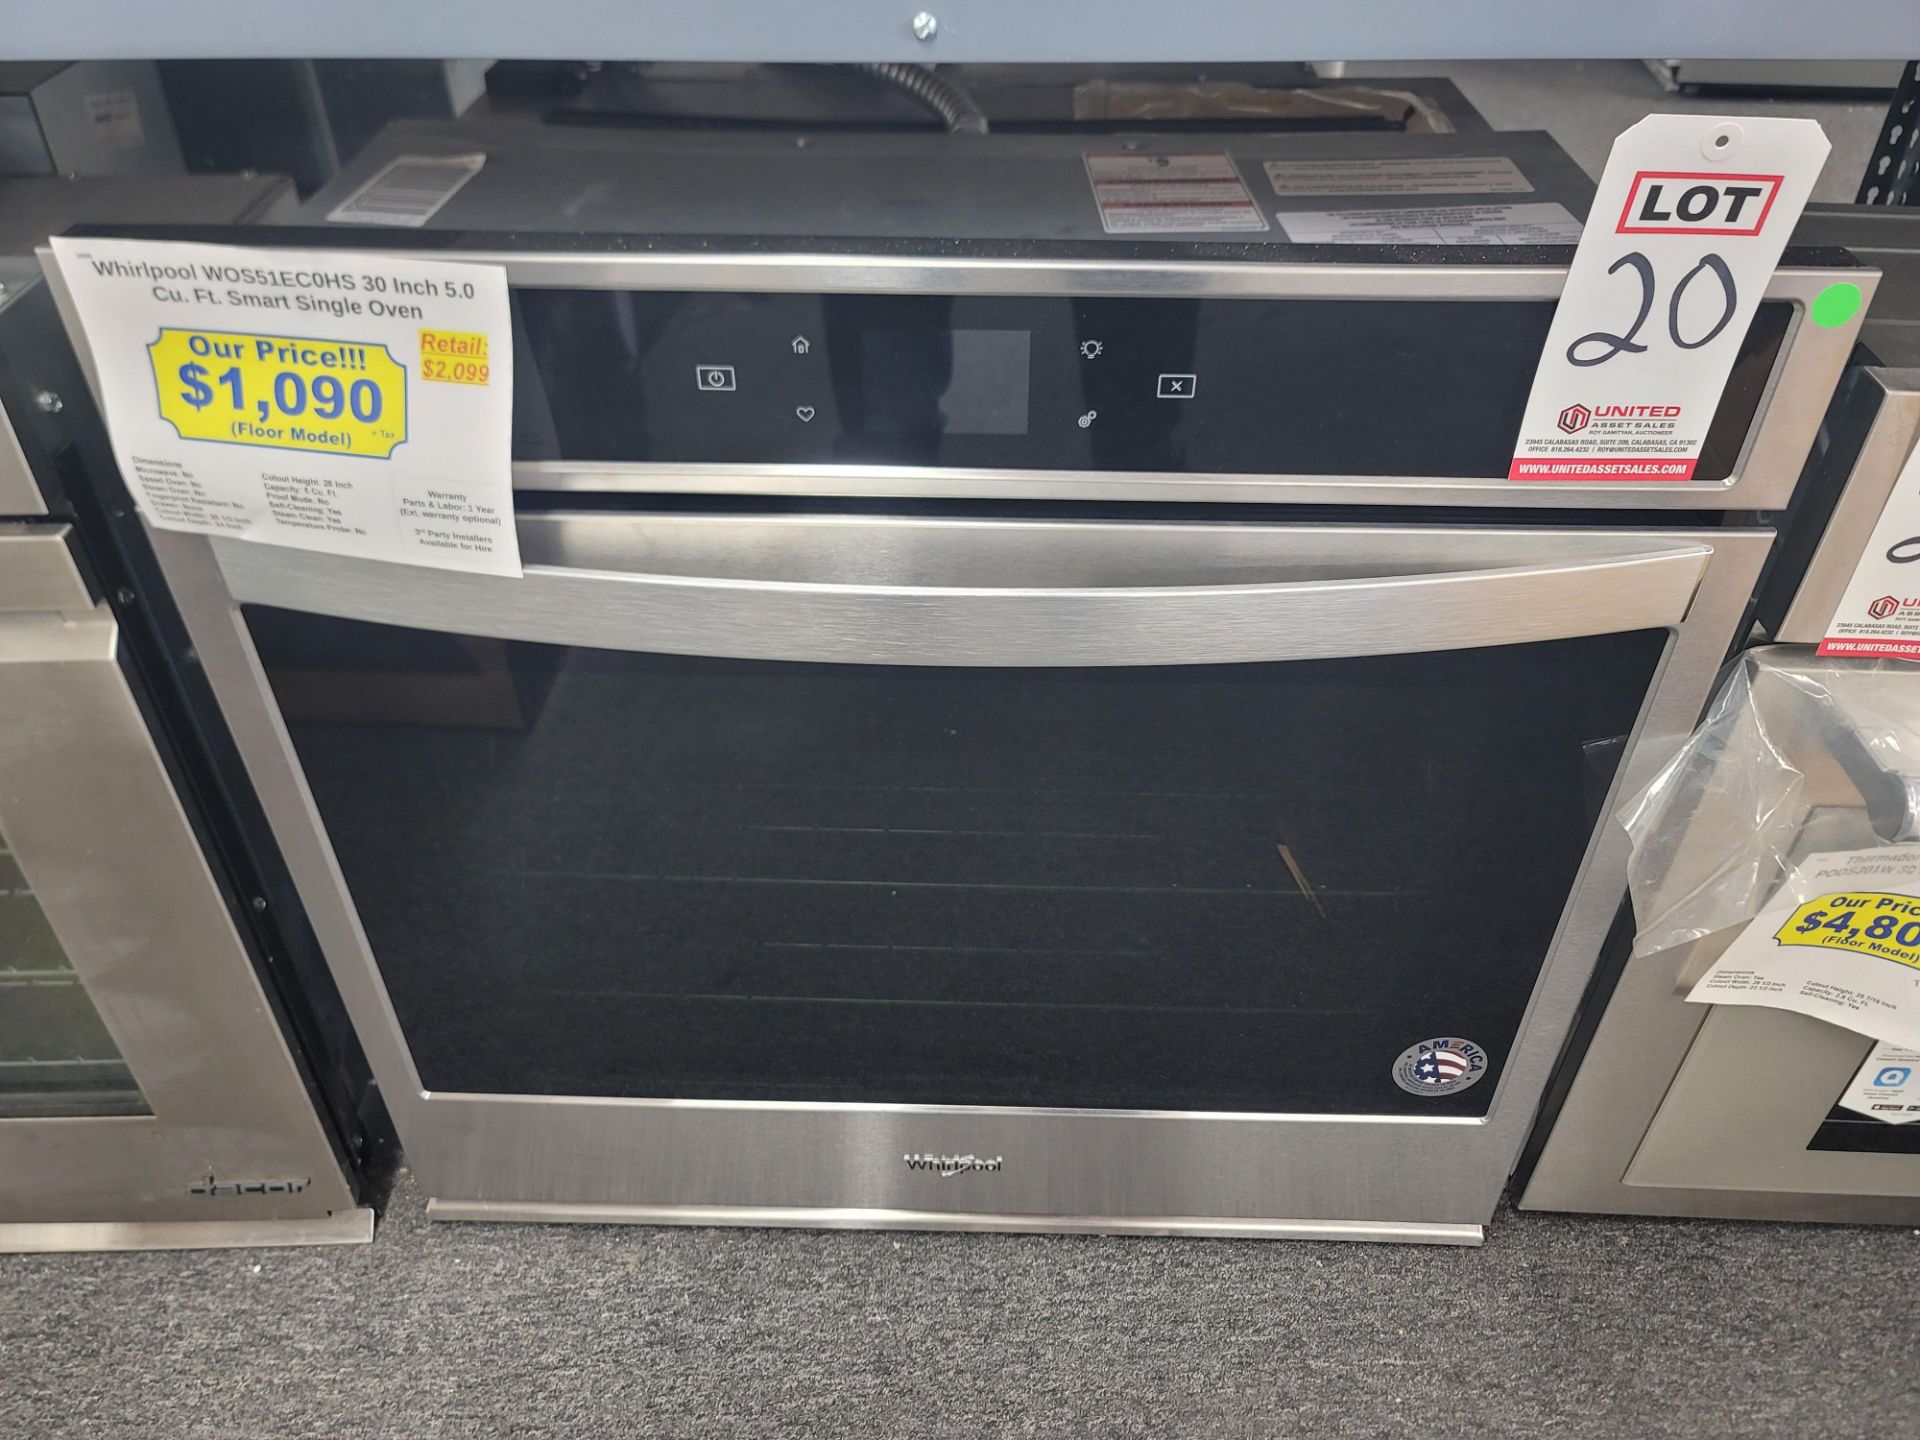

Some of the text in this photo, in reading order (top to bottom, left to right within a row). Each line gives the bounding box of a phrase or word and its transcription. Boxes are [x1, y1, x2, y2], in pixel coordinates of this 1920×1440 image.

[1639, 185, 1762, 223] LOT
[91, 260, 197, 282] Whirlpool
[362, 275, 387, 293] 30
[393, 277, 438, 297] Inch
[444, 281, 475, 299] 5.0
[152, 286, 423, 320] Cu. Ft. Smart Single Oven
[1566, 251, 1737, 367] 20
[188, 335, 367, 371] Our Price!!!
[421, 333, 488, 356] Retail:
[423, 358, 489, 382] $2,099
[178, 360, 383, 424] $1,090
[1594, 406, 1681, 417] UNITED
[231, 421, 352, 449] (Floor Model)
[261, 473, 290, 482] Cutout
[335, 480, 354, 489] Inch
[1519, 464, 1688, 475] WWW.UNITEDASSETSALES.COM
[402, 498, 425, 507] Parts
[437, 502, 466, 511] Labor:
[476, 505, 495, 514] Year
[427, 490, 467, 503] Warranty
[422, 512, 460, 522] warranty
[462, 515, 501, 526] optional)
[420, 539, 458, 549] Available
[475, 544, 492, 552] Hire
[428, 530, 450, 539] Party
[453, 532, 493, 543] Installers
[1830, 897, 1871, 908] Our
[1822, 935, 1920, 964] (Floor Model)
[1418, 1040, 1483, 1073] AMERICA
[904, 1154, 1002, 1174] Whirlpool
